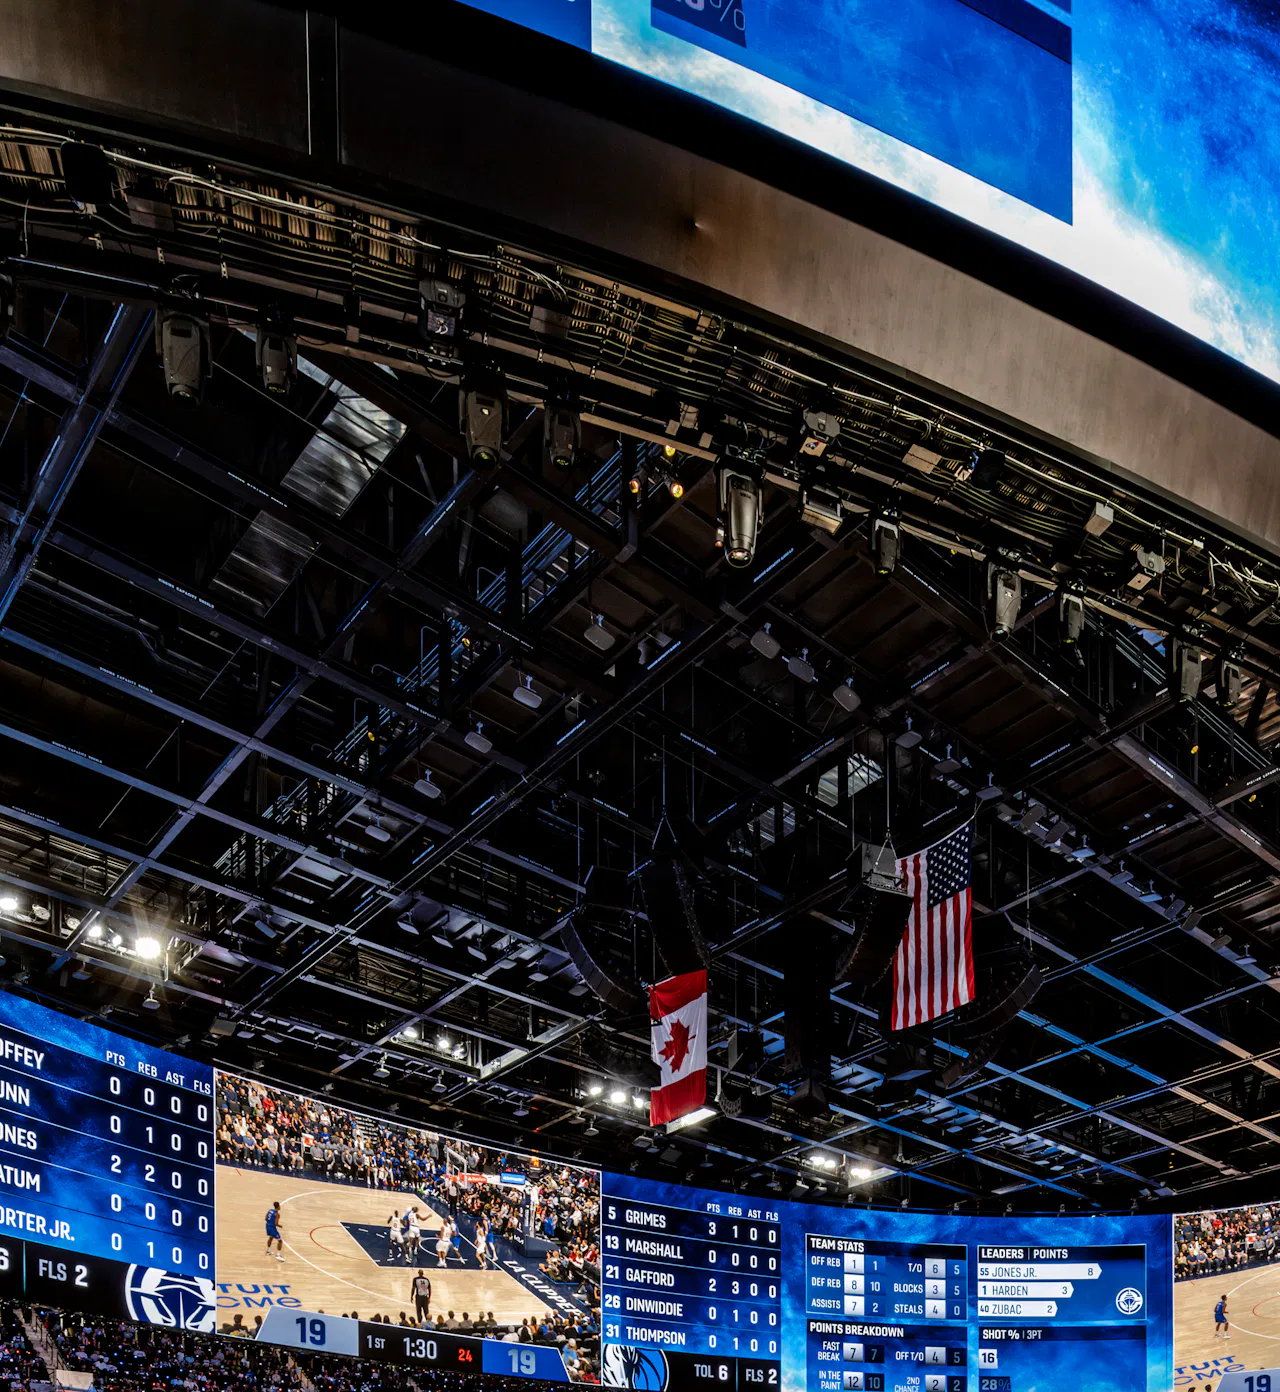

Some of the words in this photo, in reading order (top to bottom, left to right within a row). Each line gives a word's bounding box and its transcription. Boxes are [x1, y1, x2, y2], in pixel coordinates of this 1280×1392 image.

[106, 1050, 125, 1067] PTS
[138, 1061, 157, 1078] REB
[166, 1071, 184, 1086] AST
[194, 1079, 210, 1095] FLS
[608, 1206, 616, 1219] 5
[626, 1210, 666, 1228] GRIMES
[707, 1203, 720, 1213] PTS
[728, 1207, 742, 1216] REB
[748, 1209, 761, 1219] AST
[766, 1212, 778, 1221] FLS
[49, 1218, 75, 1242] JR.
[605, 1235, 619, 1249] 13
[626, 1239, 683, 1259] MARSHALL
[810, 1238, 835, 1250] TEAM
[837, 1241, 864, 1252] STATS
[982, 1248, 1024, 1258] LEADERS
[1033, 1249, 1068, 1259] POINTS
[503, 1259, 522, 1273] LA
[811, 1256, 825, 1265] OFF
[827, 1258, 840, 1267] REB
[38, 1259, 67, 1282] FLS
[75, 1264, 88, 1287] 2
[908, 1263, 922, 1272] T/O
[980, 1268, 989, 1276] 55
[992, 1267, 1021, 1277] JONES
[1023, 1267, 1037, 1278] JR.
[1088, 1268, 1093, 1276] 8
[606, 1265, 619, 1279] 21
[626, 1268, 674, 1286] GAFFORD
[812, 1277, 825, 1286] DEF
[827, 1279, 841, 1288] REB
[870, 1282, 880, 1291] 10
[894, 1283, 923, 1293] BLOCKS
[982, 1285, 986, 1294] 1
[992, 1286, 1028, 1295] HARDEN
[605, 1294, 620, 1308] 26
[626, 1297, 683, 1316] DINWIDDIE
[811, 1299, 840, 1309] ASSISTS
[895, 1304, 923, 1314] STEALS
[980, 1305, 989, 1313] 40
[992, 1304, 1022, 1314] ZUBAC
[295, 1317, 326, 1345] 19
[606, 1324, 619, 1337] 31
[626, 1326, 685, 1345] THOMPSON
[810, 1322, 843, 1334] POINTS
[845, 1324, 904, 1337] BREAKDOWN
[983, 1329, 1006, 1339] SHOT
[1008, 1330, 1019, 1339] %
[1027, 1330, 1042, 1339] 3PT
[403, 1336, 437, 1360] 1:30
[458, 1349, 473, 1362] 24
[823, 1341, 840, 1350] FAST
[508, 1347, 536, 1374] 19
[818, 1351, 840, 1361] BREAK
[896, 1351, 909, 1360] OFF
[911, 1352, 924, 1361] T/O
[982, 1353, 994, 1363] 16
[694, 1364, 714, 1378] TOL
[719, 1365, 728, 1380] 6
[746, 1369, 763, 1382] FLS
[768, 1369, 777, 1384] 2
[819, 1370, 826, 1379] IN
[828, 1371, 840, 1380] THE
[821, 1381, 840, 1390] PAINT
[848, 1376, 858, 1388] 12
[869, 1377, 880, 1389] 10
[907, 1376, 920, 1384] 2ND
[894, 1385, 920, 1392] CHANCE
